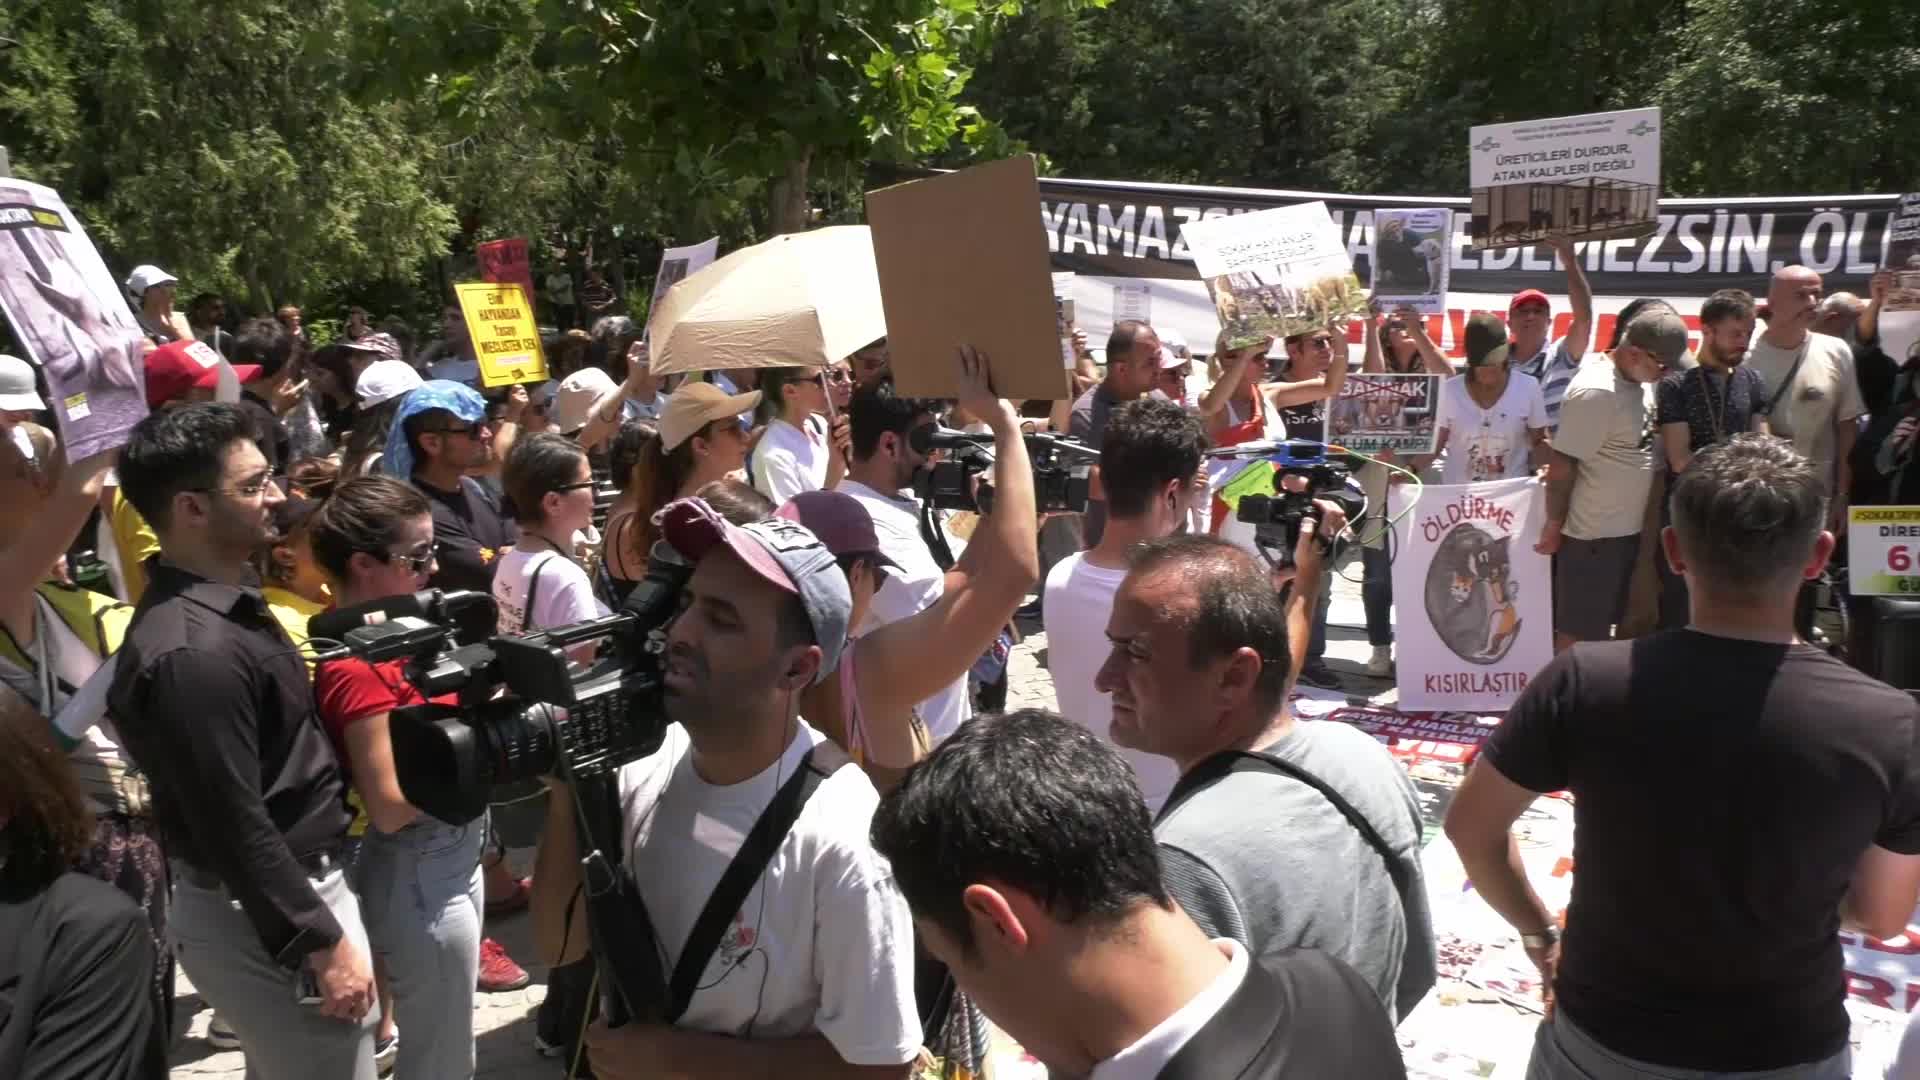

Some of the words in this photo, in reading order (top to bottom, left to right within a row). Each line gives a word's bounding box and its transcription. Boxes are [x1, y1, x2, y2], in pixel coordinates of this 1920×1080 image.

[1495, 147, 1571, 166] ÜRETİCİLERİ
[1492, 169, 1526, 182] ATAN
[1528, 161, 1590, 178] KALPLERİ
[1421, 494, 1515, 543] ÖLDÜRME
